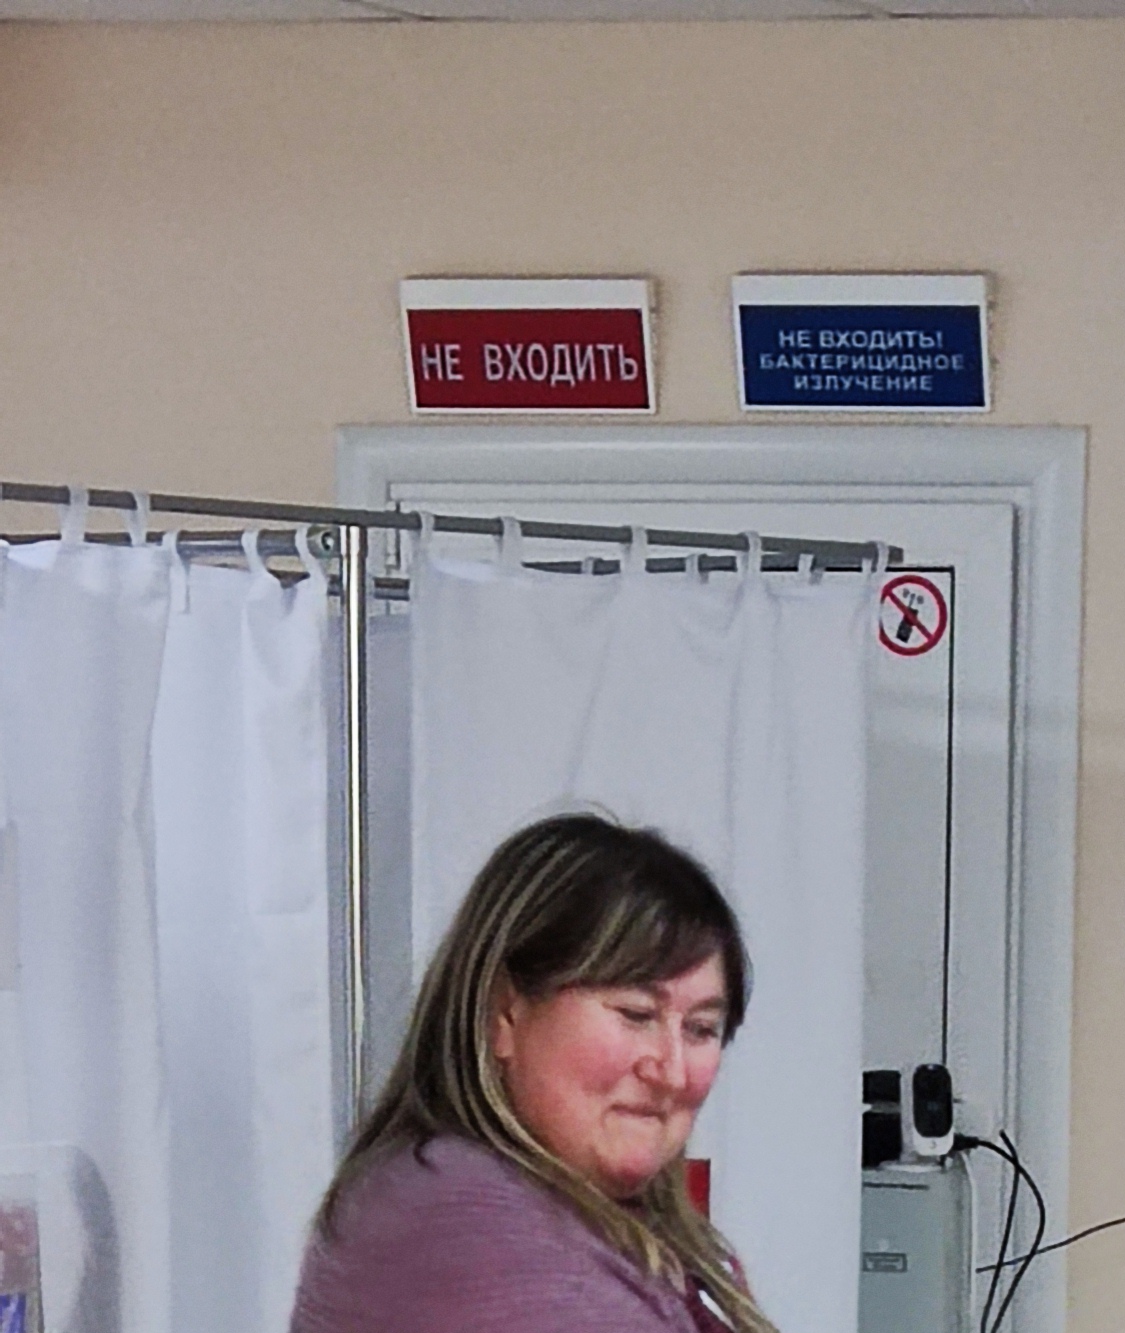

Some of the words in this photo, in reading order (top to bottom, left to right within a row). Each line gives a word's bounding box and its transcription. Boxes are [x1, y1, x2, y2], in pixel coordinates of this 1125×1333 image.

[778, 330, 811, 348] НЕ
[818, 330, 943, 350] ВХОДИТЬ!
[421, 342, 464, 381] НЕ
[483, 342, 639, 388] ВХОДИТЬ
[759, 353, 964, 372] БАКТЕРИЦИДНОЕ
[793, 375, 933, 391] ИЗЛУЧЕНИЕ
